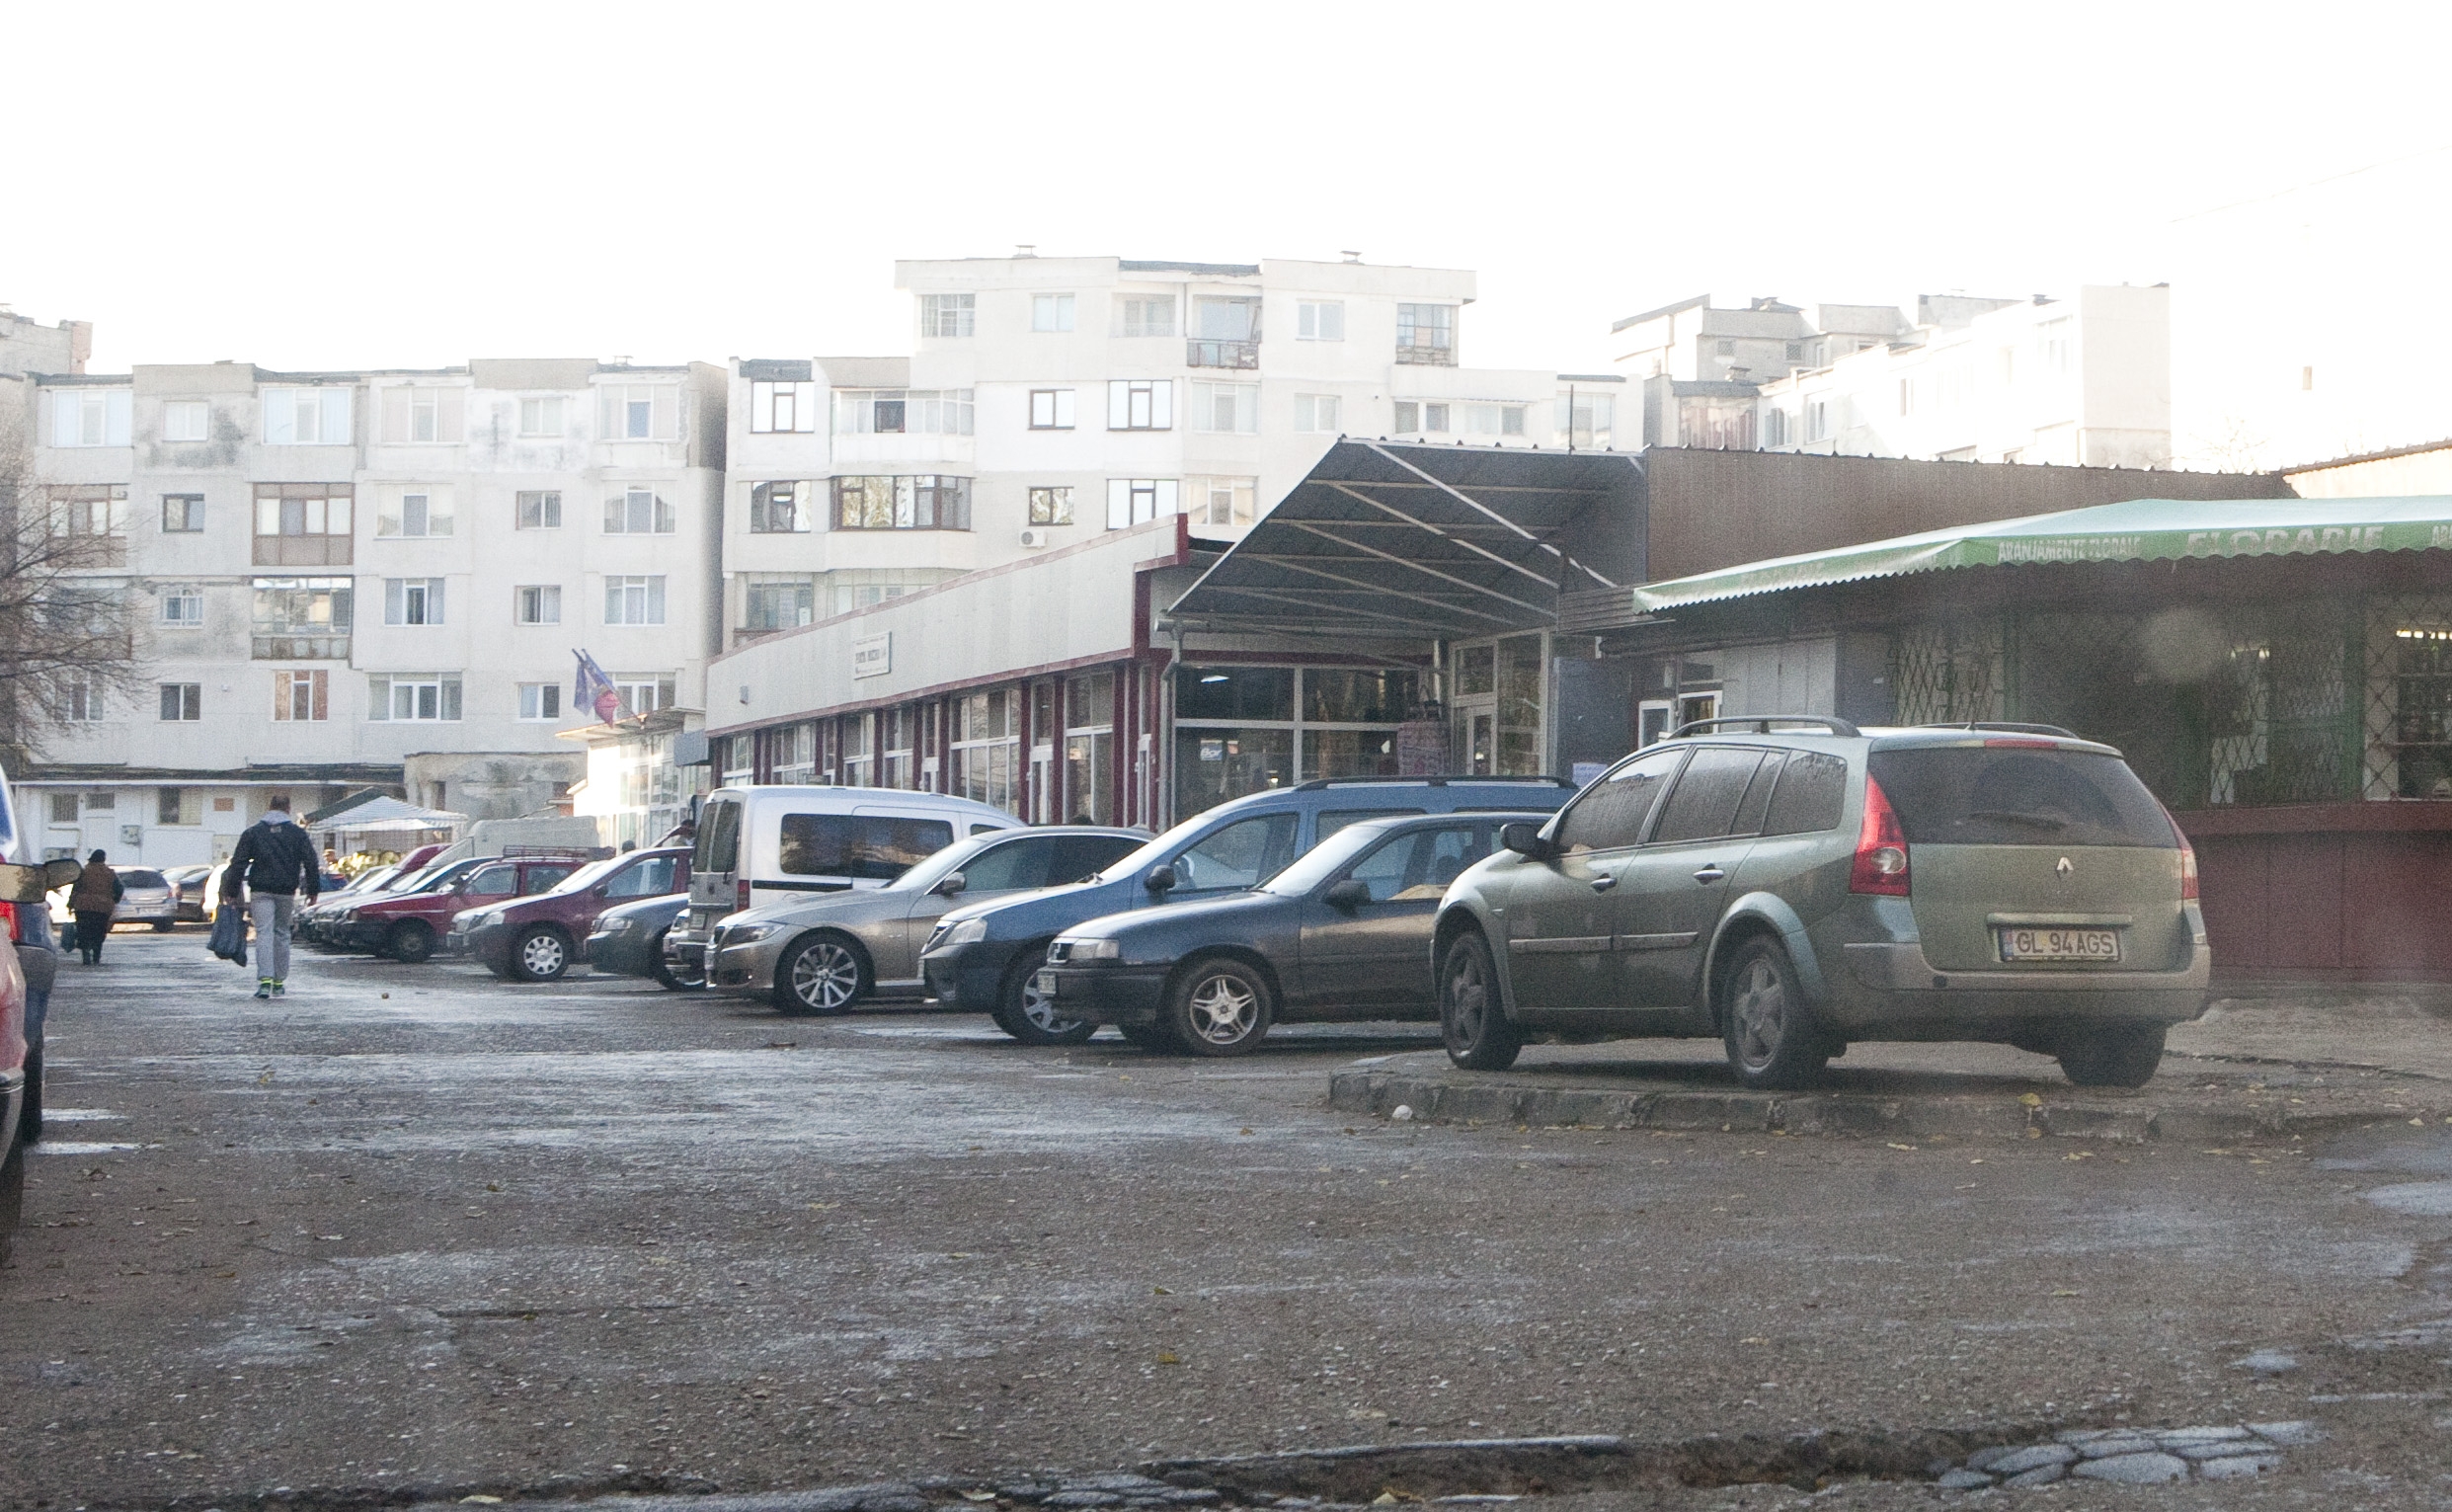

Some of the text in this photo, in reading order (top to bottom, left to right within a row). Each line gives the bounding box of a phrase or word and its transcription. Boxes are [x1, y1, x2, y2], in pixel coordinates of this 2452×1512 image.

[2017, 931, 2114, 955] GL 94 AGS
